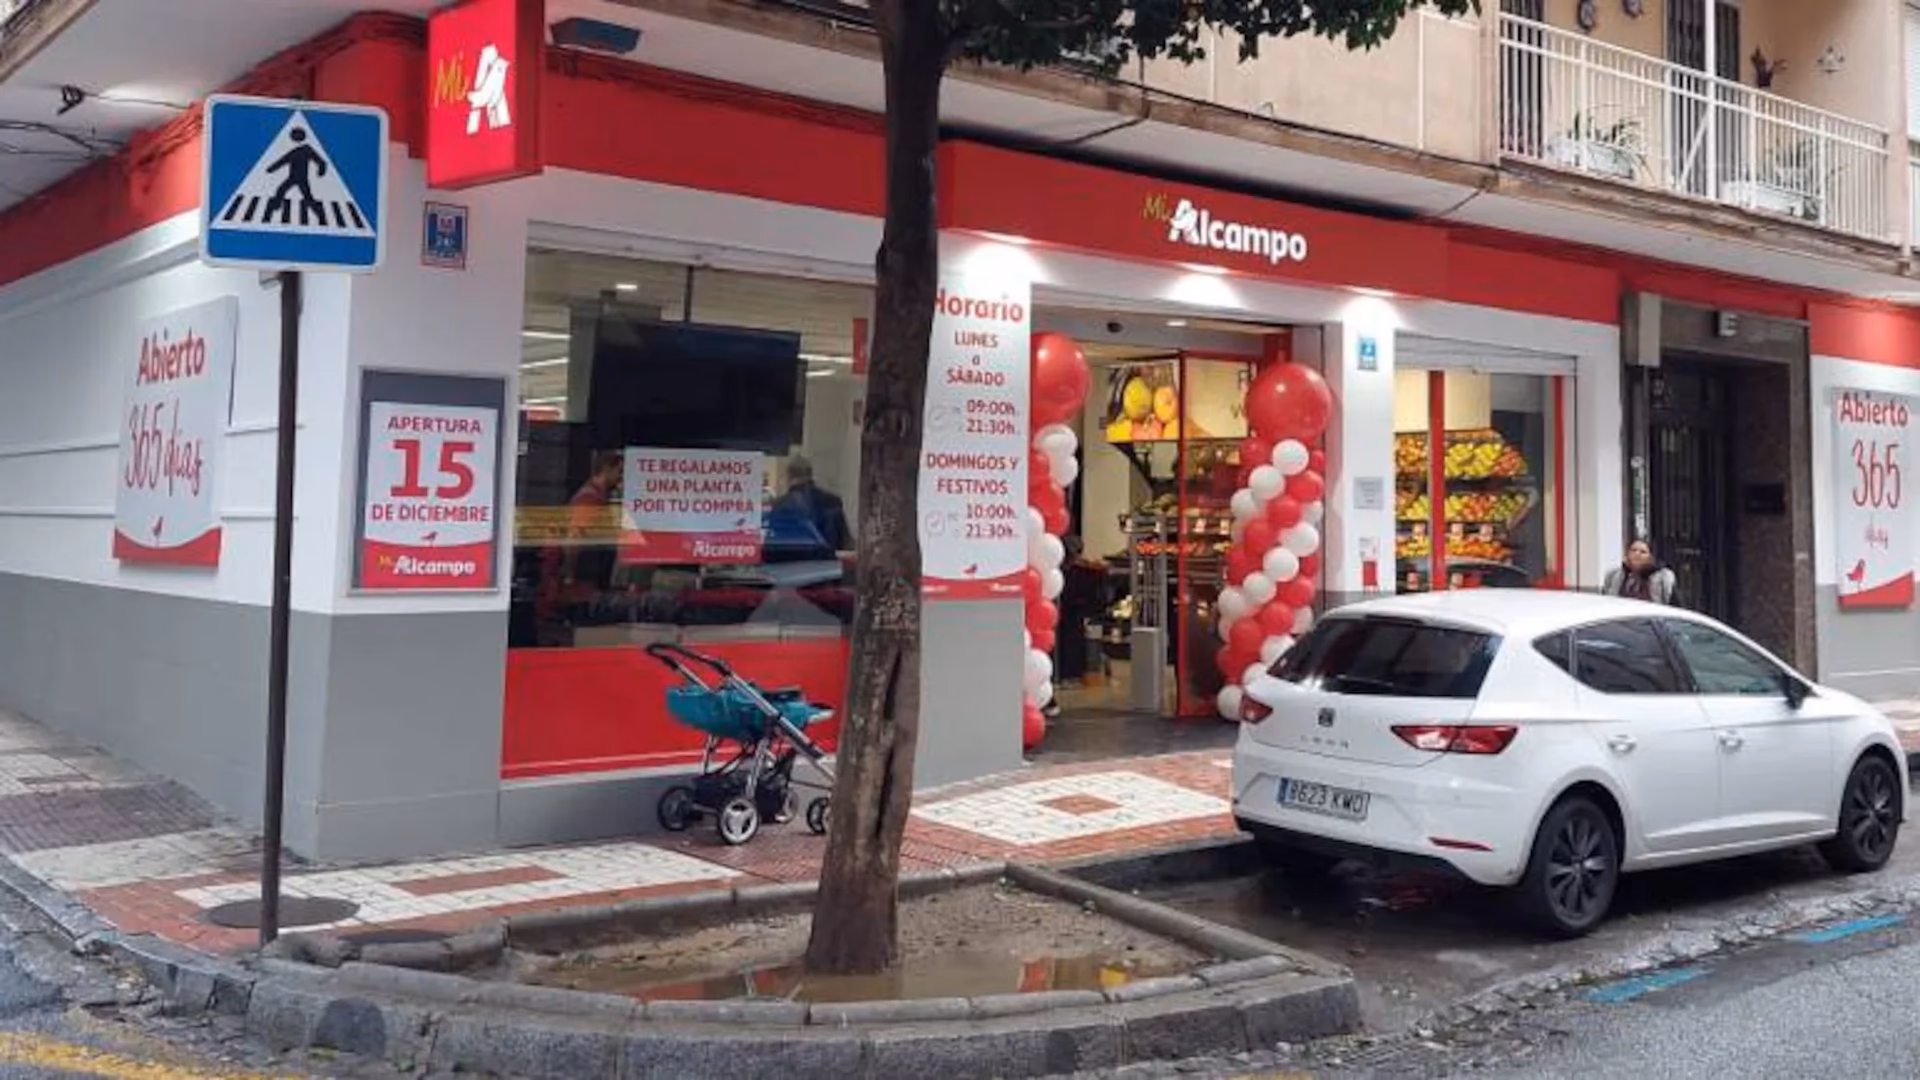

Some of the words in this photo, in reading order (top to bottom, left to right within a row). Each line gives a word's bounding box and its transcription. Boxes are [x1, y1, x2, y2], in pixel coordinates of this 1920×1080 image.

[434, 50, 468, 108] Mi
[1142, 194, 1170, 221] Mi
[1168, 198, 1307, 265] Alcampo
[954, 332, 998, 348] LUNES
[136, 326, 205, 386] Abierto
[972, 355, 980, 365] a
[1840, 391, 1908, 427] Abierto
[388, 415, 481, 434] APERTURA
[125, 402, 164, 490] 365
[390, 438, 476, 499] 15
[637, 458, 656, 472] TE
[660, 459, 752, 475] REGALAMOS
[927, 453, 1006, 470] DOMINGOS
[1010, 456, 1019, 470] Y
[1852, 438, 1901, 509] 365
[646, 480, 680, 492] UNA
[684, 481, 743, 493] PLANTA
[936, 477, 1008, 495] FESTIVOS
[372, 504, 394, 521] DE
[399, 504, 490, 522] DICIEMBRE
[633, 499, 665, 512] POR
[670, 499, 689, 512] TU
[692, 500, 754, 513] COMPRA
[692, 541, 756, 558] Alcampo
[393, 555, 477, 577] Alcampo
[1291, 780, 1327, 805] 8623
